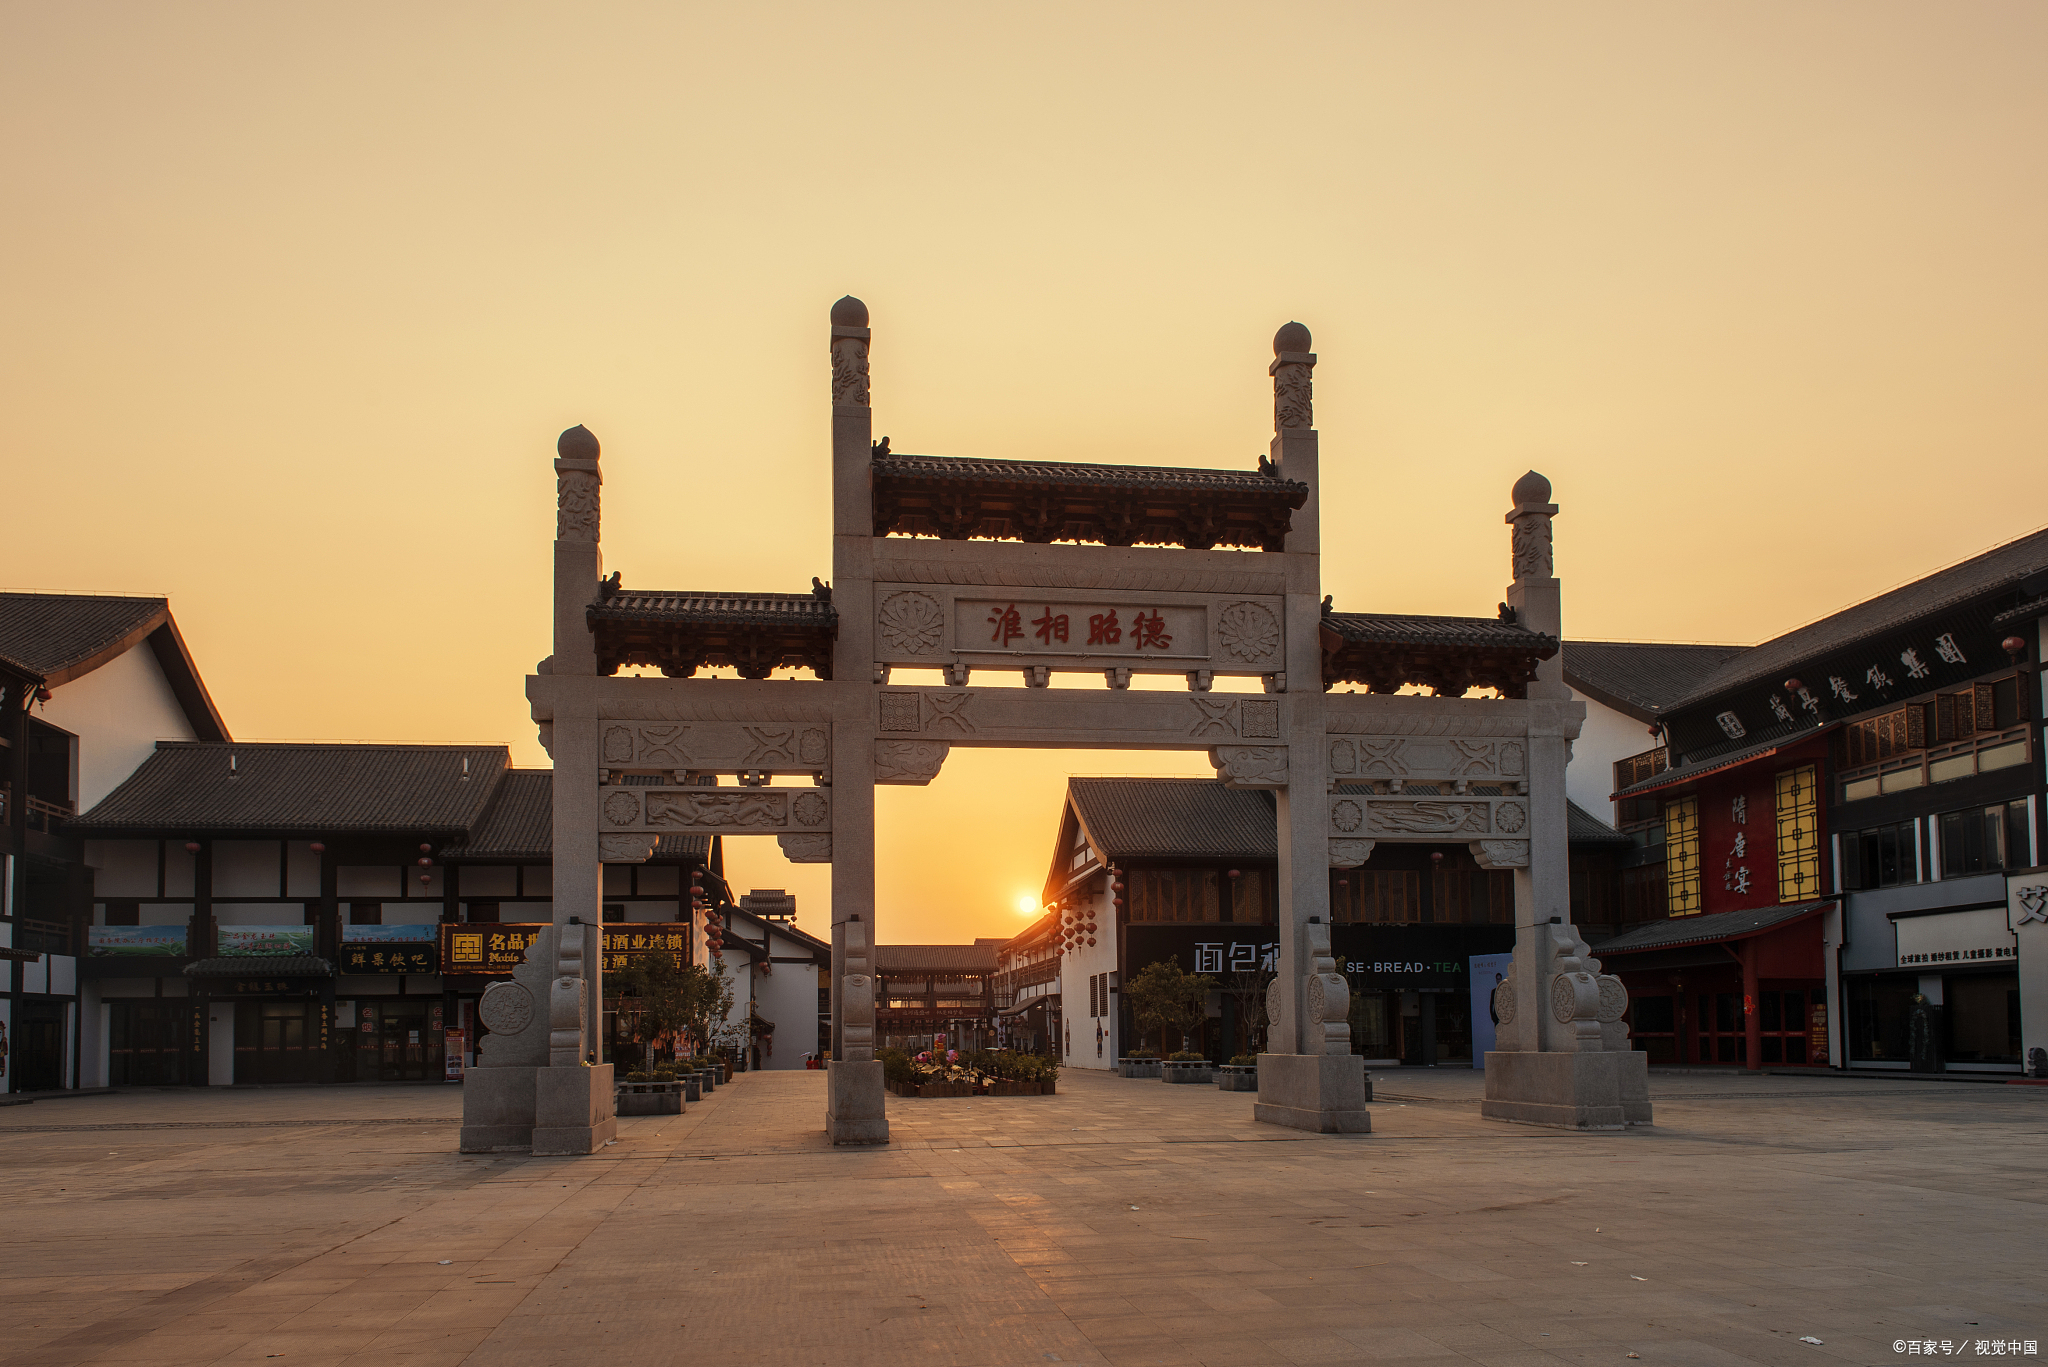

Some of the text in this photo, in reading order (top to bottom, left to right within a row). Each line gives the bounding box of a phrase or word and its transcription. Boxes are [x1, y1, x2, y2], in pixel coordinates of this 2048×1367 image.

[2016, 885, 2048, 925] 艾
[1374, 961, 1423, 973] BREAD
[1434, 961, 1462, 973] TEA
